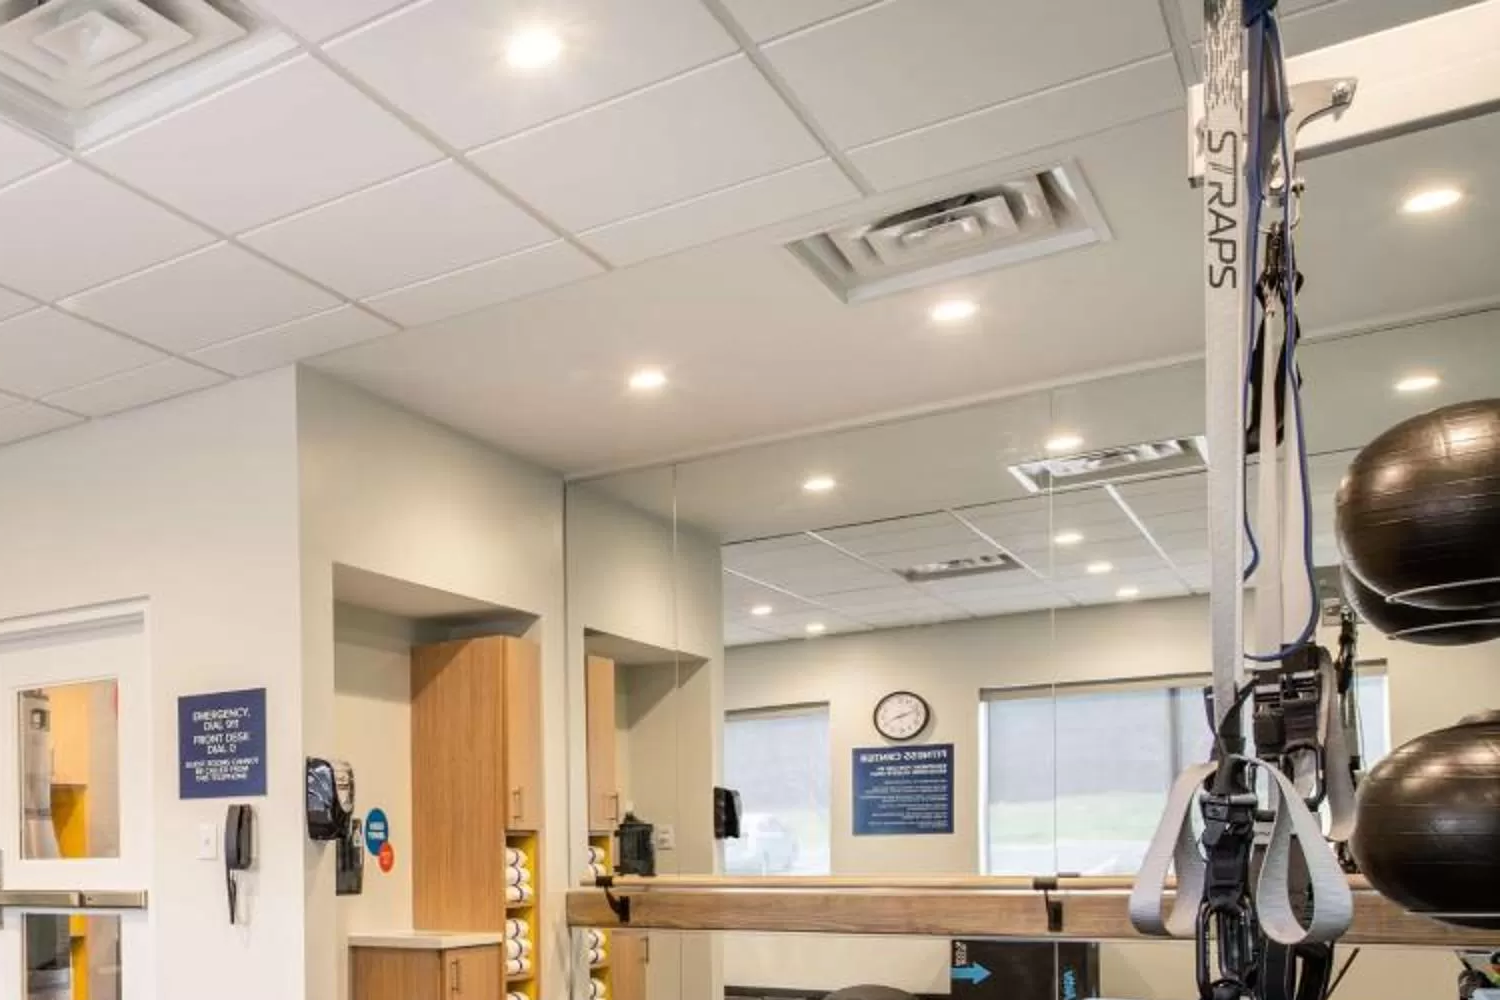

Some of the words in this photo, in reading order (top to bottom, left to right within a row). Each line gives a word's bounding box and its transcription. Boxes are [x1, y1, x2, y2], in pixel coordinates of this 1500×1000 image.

[1208, 129, 1237, 289] STRAPS
[203, 721, 224, 731] DIAL
[193, 733, 224, 745] FRONT
[226, 731, 248, 743] DESK
[207, 744, 226, 754] DIAL
